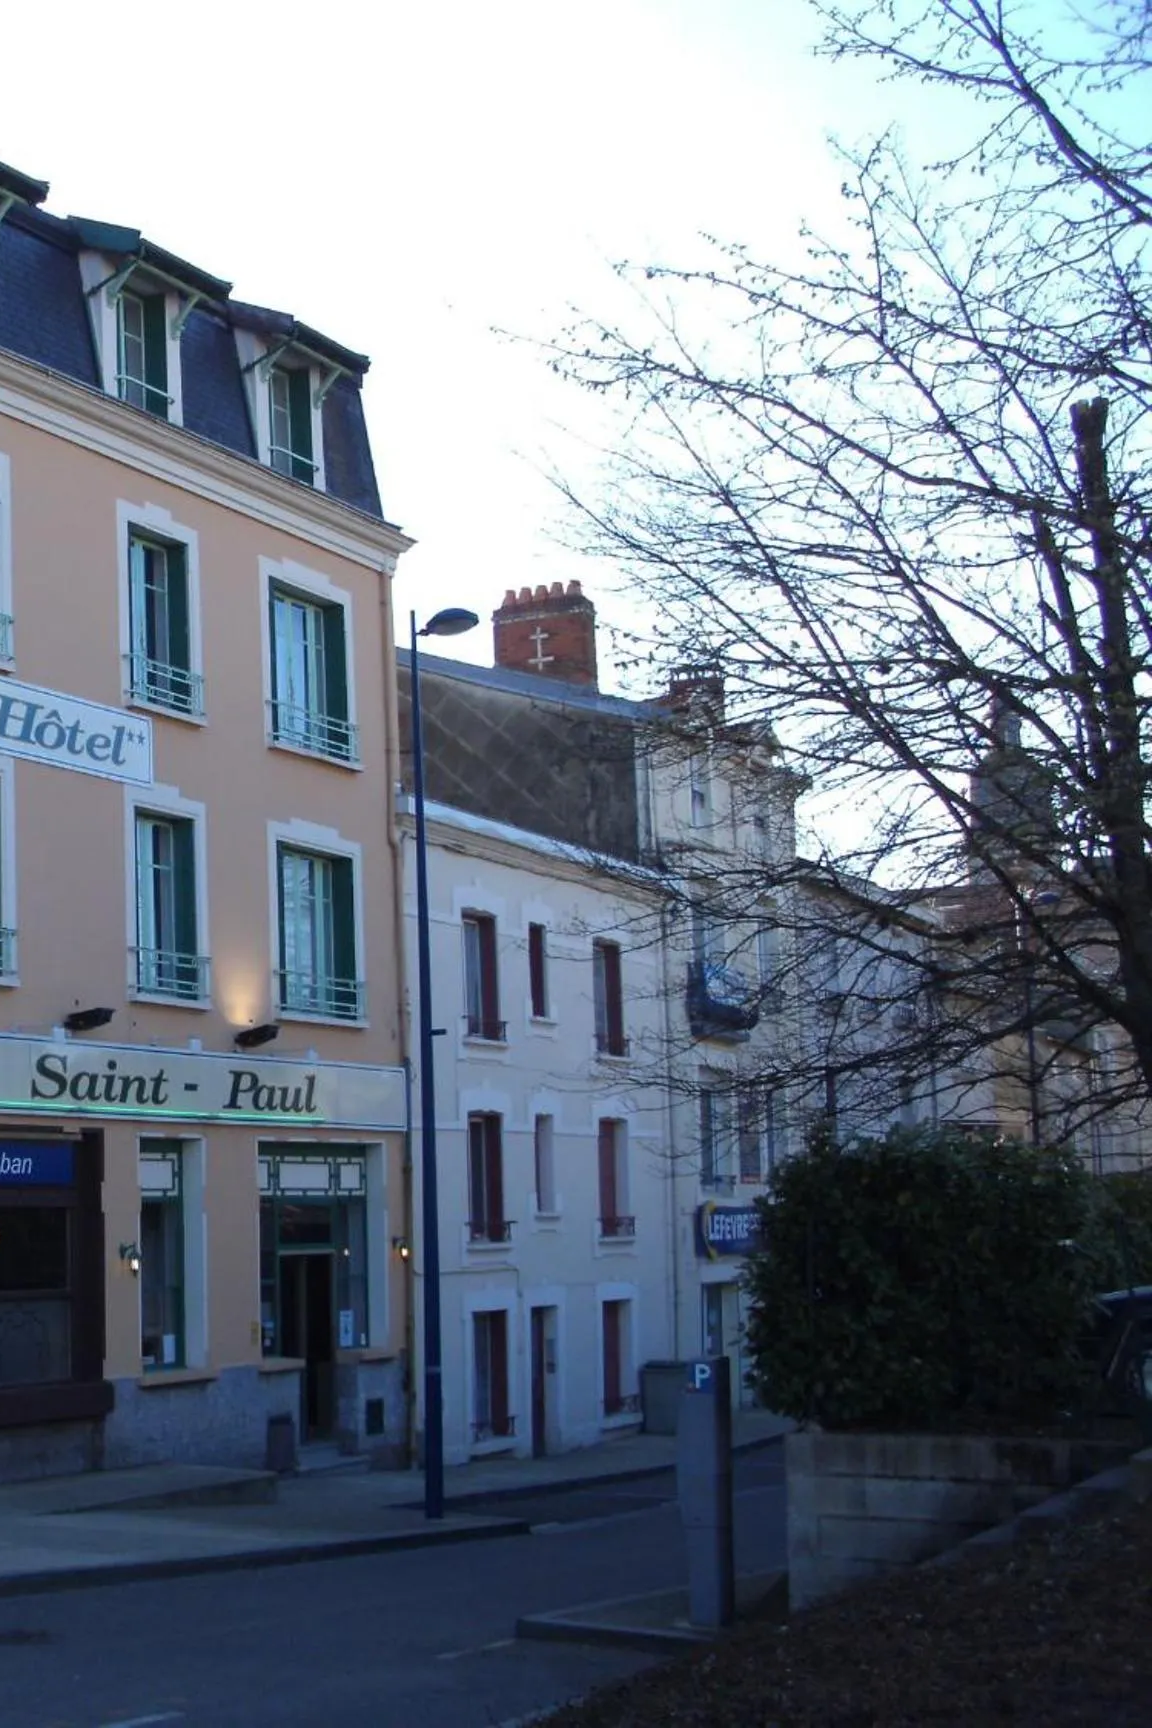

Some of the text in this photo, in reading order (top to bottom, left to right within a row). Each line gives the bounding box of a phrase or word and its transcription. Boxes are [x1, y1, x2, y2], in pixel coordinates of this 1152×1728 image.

[31, 1053, 169, 1104] Saint
[223, 1069, 317, 1113] Paul
[695, 1363, 711, 1389] P
